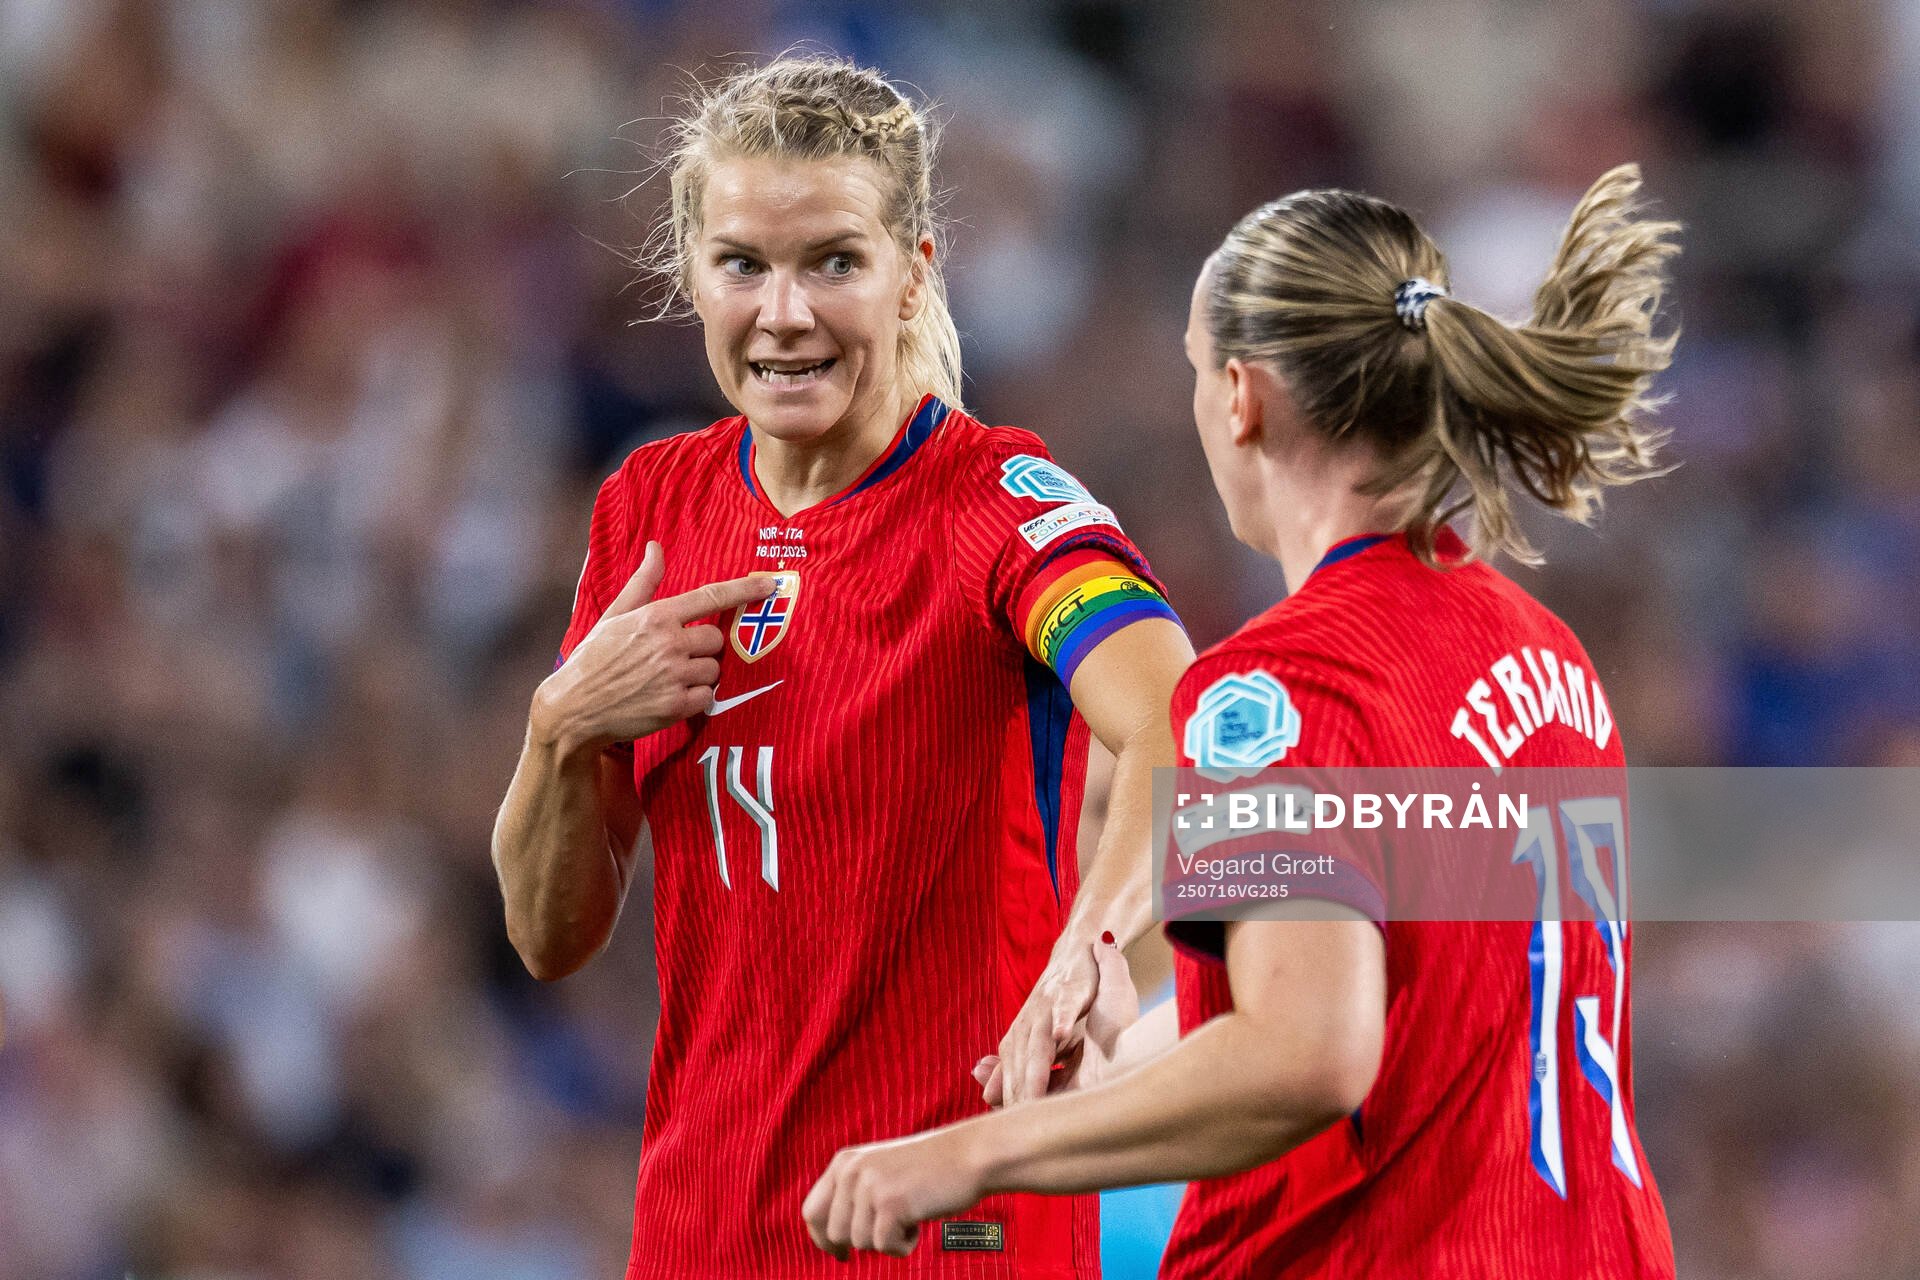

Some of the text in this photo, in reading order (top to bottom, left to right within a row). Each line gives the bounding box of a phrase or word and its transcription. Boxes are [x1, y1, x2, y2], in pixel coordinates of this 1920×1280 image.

[759, 526, 778, 540] NOR
[785, 527, 804, 540] ITA
[1023, 518, 1046, 533] UEFA
[1029, 510, 1113, 542] FOUNDATIO
[696, 746, 779, 893] 14
[1511, 796, 1643, 1201] 19
